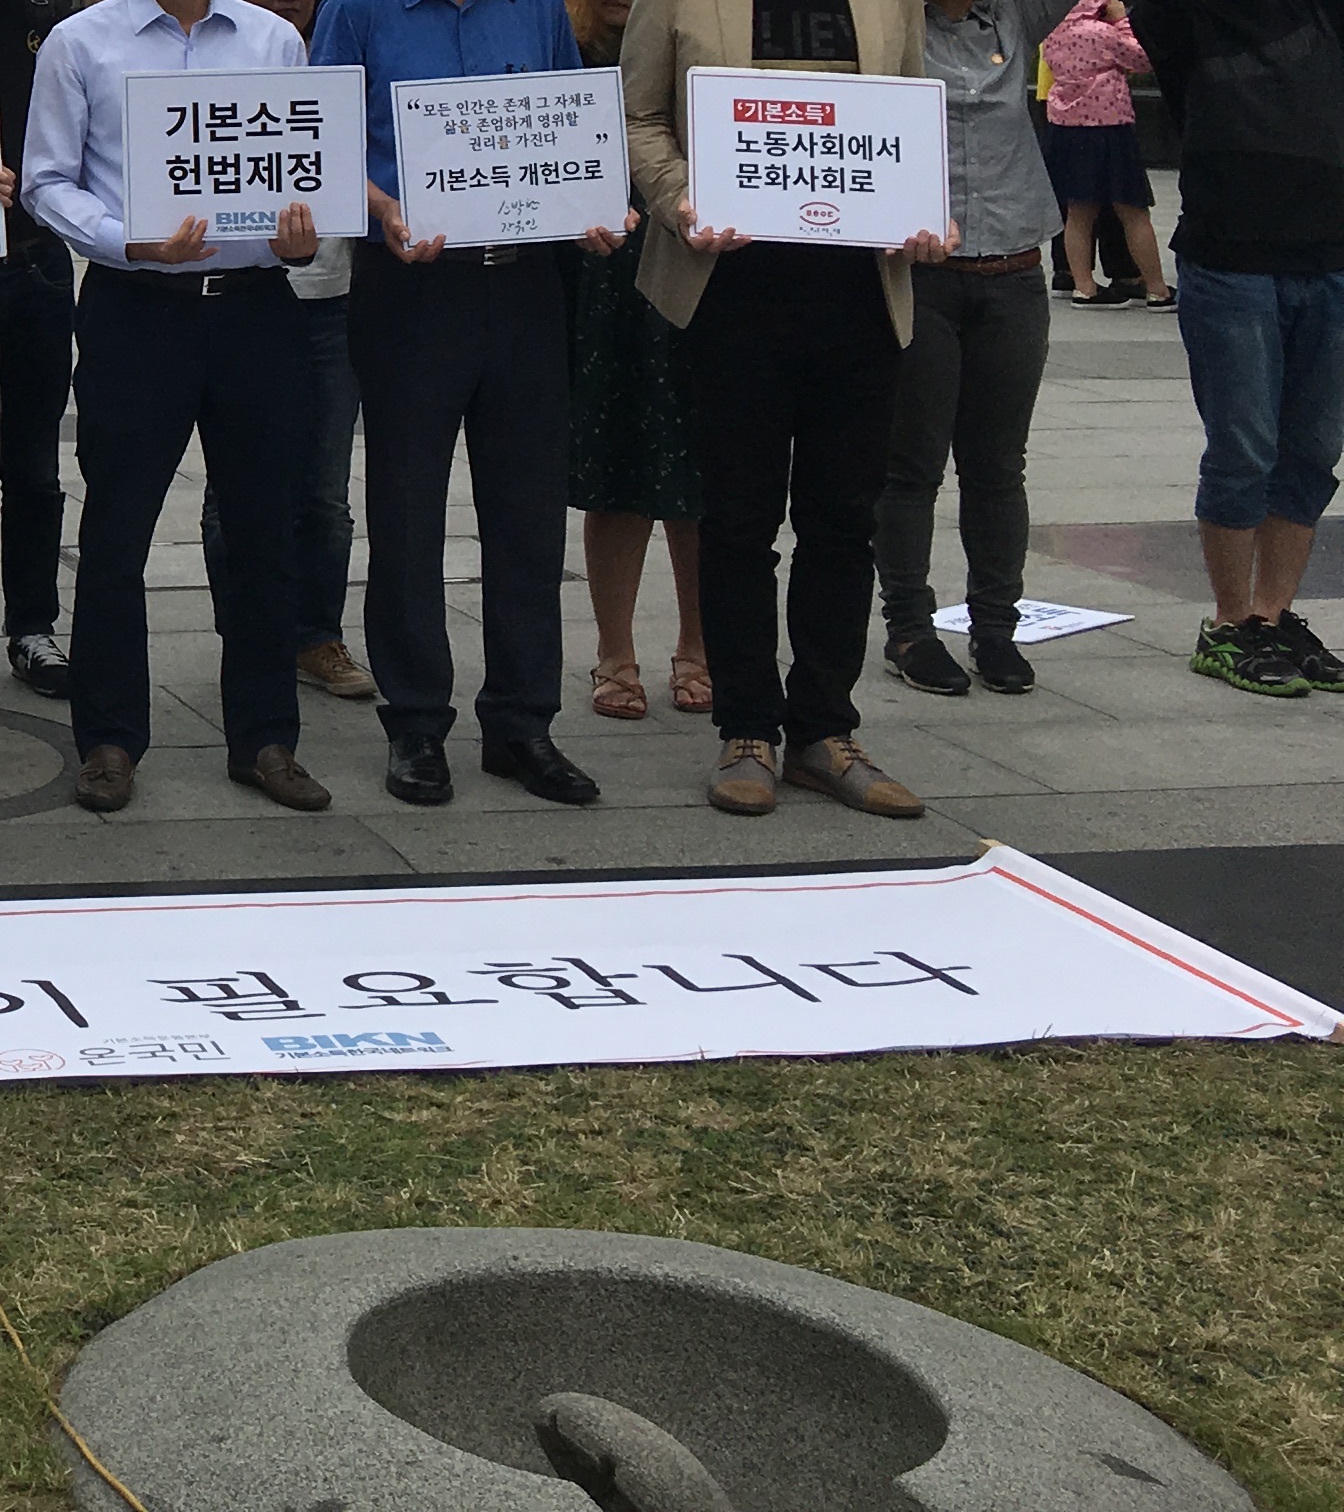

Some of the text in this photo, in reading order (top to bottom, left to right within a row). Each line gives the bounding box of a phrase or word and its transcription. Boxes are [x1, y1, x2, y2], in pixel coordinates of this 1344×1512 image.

[456, 99, 499, 116] 인간은
[503, 95, 531, 113] 존재
[536, 96, 550, 110] 그
[554, 92, 597, 109] 자체로
[165, 100, 324, 144] 기본소득
[443, 111, 579, 136] 삶을 존엄하게 영위할
[469, 135, 511, 152] 권리를
[515, 131, 558, 148] 가진다
[735, 130, 901, 163] 노동사회에서
[165, 150, 322, 196] 헌법제정
[425, 160, 604, 193] 기본소득 개헌으로
[735, 163, 876, 194] 문화사회로
[215, 211, 276, 224] BIKN
[146, 951, 980, 1021] 필요합니다
[78, 1040, 231, 1066] 온국민
[261, 1031, 448, 1052] BIKN
[274, 1046, 455, 1059] 기본소득한국네트워크
